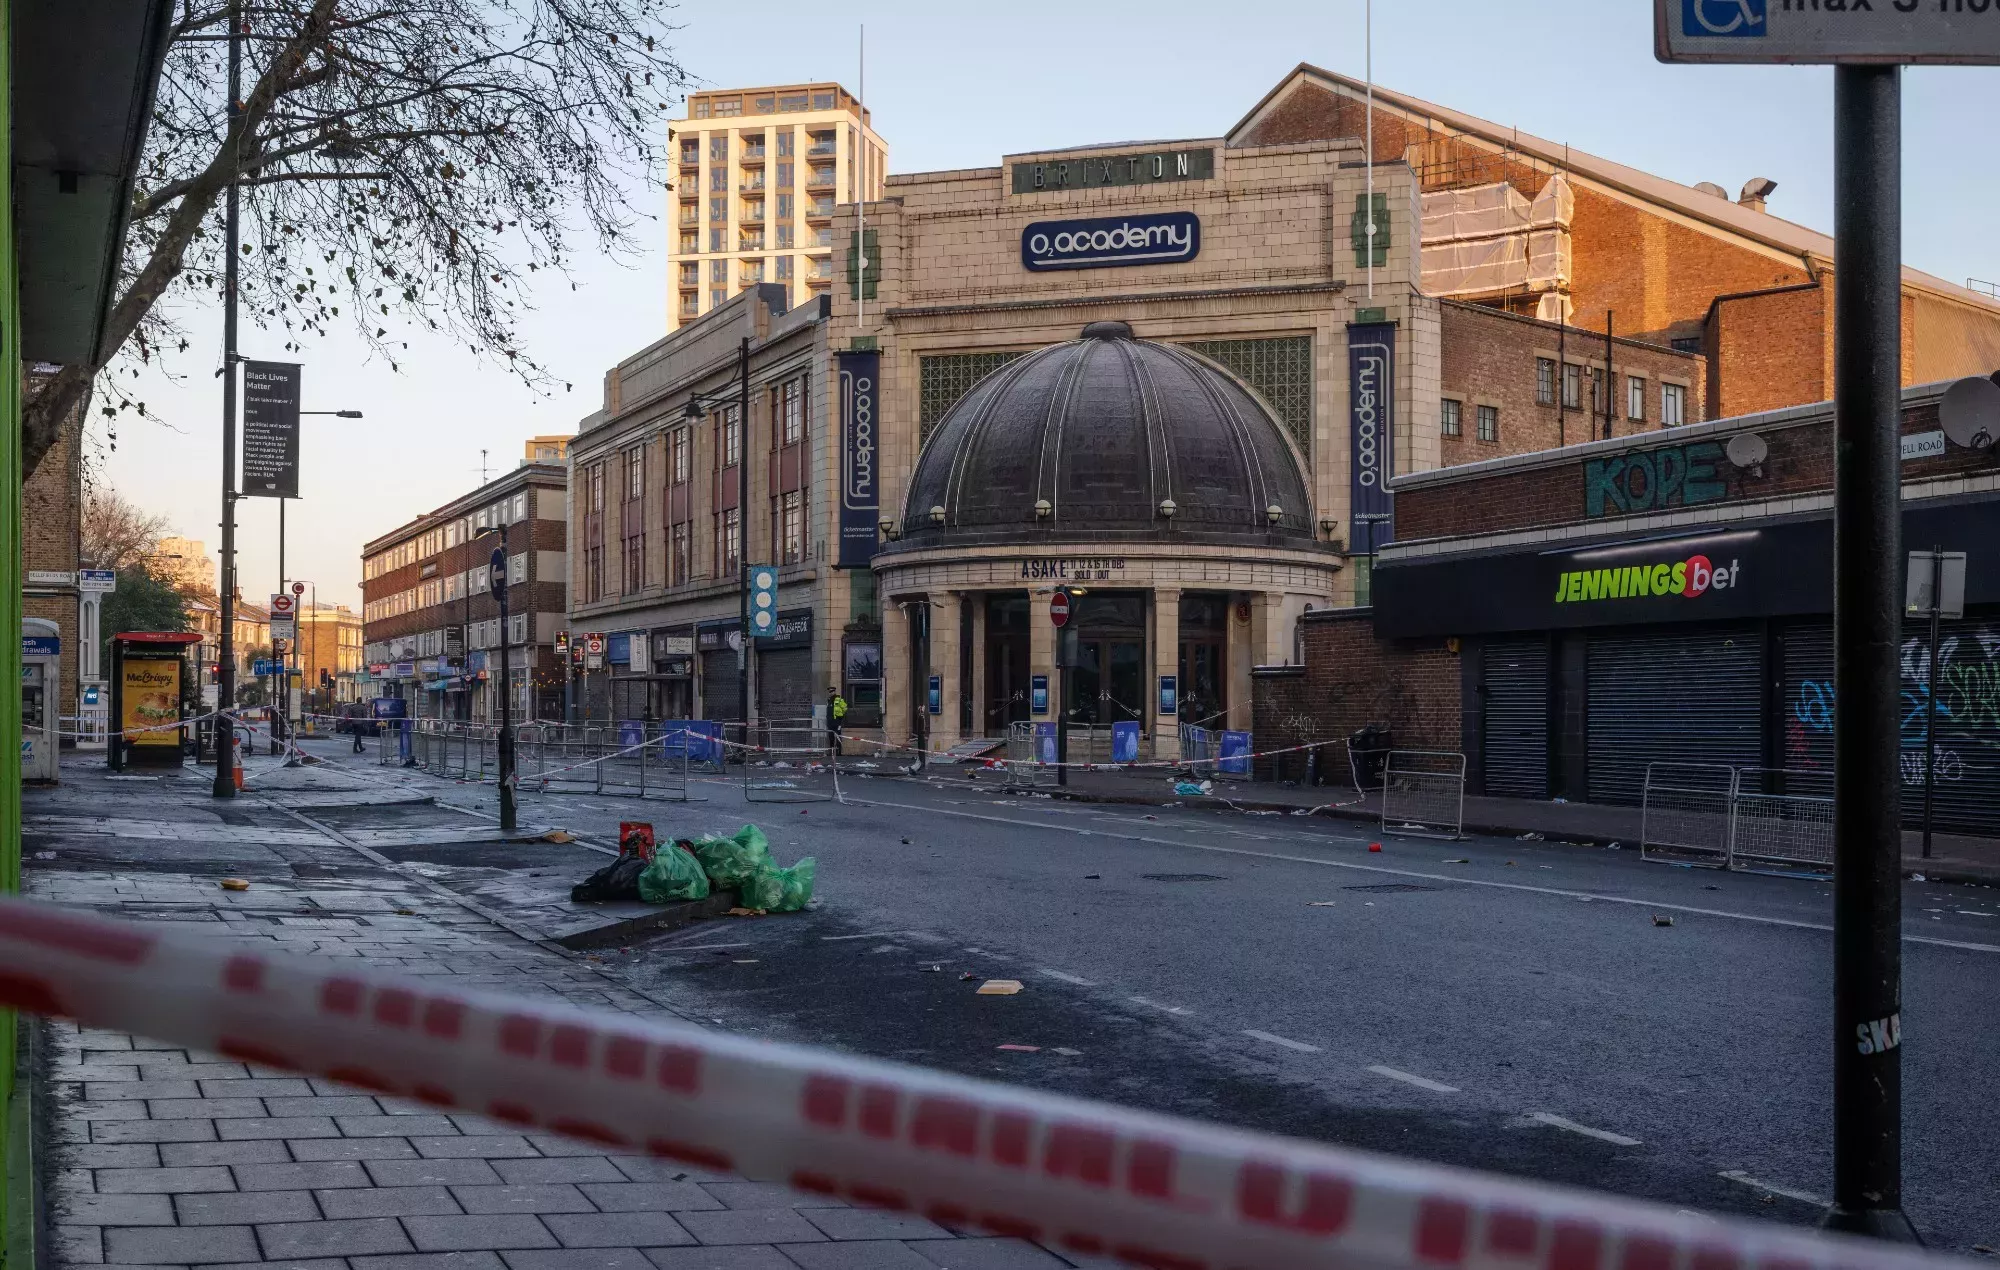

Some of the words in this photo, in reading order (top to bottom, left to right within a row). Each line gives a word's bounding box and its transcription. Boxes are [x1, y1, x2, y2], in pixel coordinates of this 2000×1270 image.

[1034, 154, 1187, 187] BRIXTON
[246, 372, 267, 380] Black
[268, 373, 288, 382] Lives
[246, 382, 271, 390] Matter
[1902, 443, 1915, 455] ELL
[1918, 440, 1943, 452] ROAD
[1021, 560, 1067, 579] ASAKE
[1111, 560, 1124, 569] DEC
[1074, 570, 1090, 579] SOLD
[126, 669, 173, 686] McCrispy
